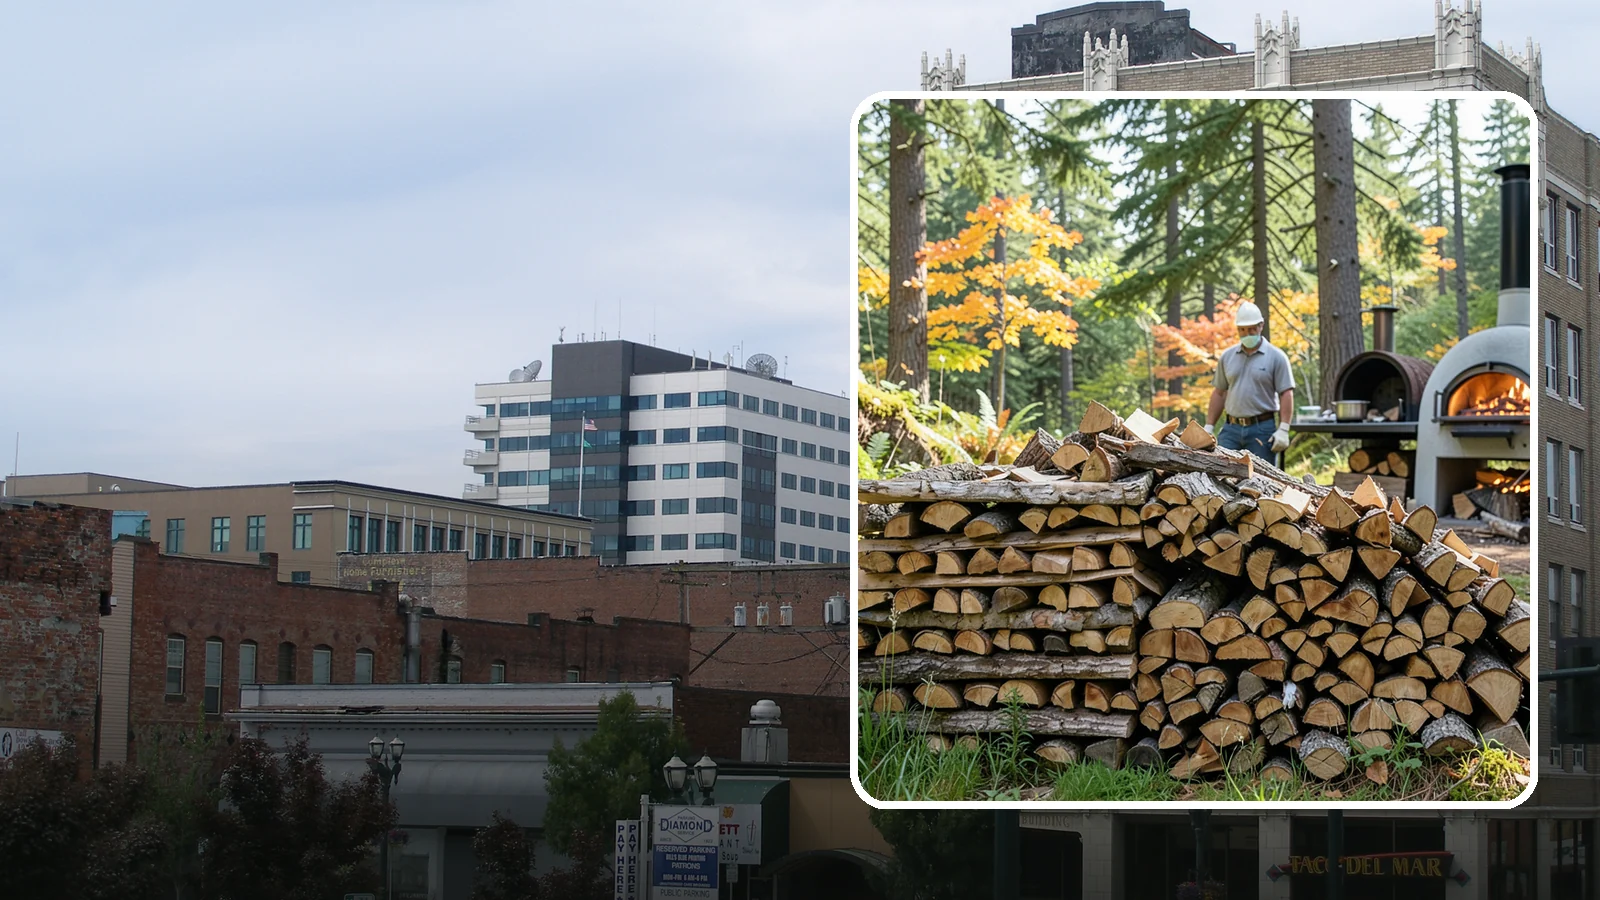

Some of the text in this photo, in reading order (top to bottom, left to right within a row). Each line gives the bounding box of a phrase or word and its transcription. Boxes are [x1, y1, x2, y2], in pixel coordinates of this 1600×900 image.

[343, 565, 427, 577] Home Furnishers
[660, 818, 713, 832] DIAMOND
[1022, 815, 1069, 828] BUILDING
[656, 845, 716, 854] RESERVED PARKING
[617, 825, 625, 893] PAY HERE
[628, 824, 636, 893] PAY HERE
[721, 851, 739, 862] Soup
[671, 862, 701, 870] PATRONS
[1289, 855, 1442, 877] TAC DEL MAR
[660, 888, 710, 898] PUBLIC PARKING
